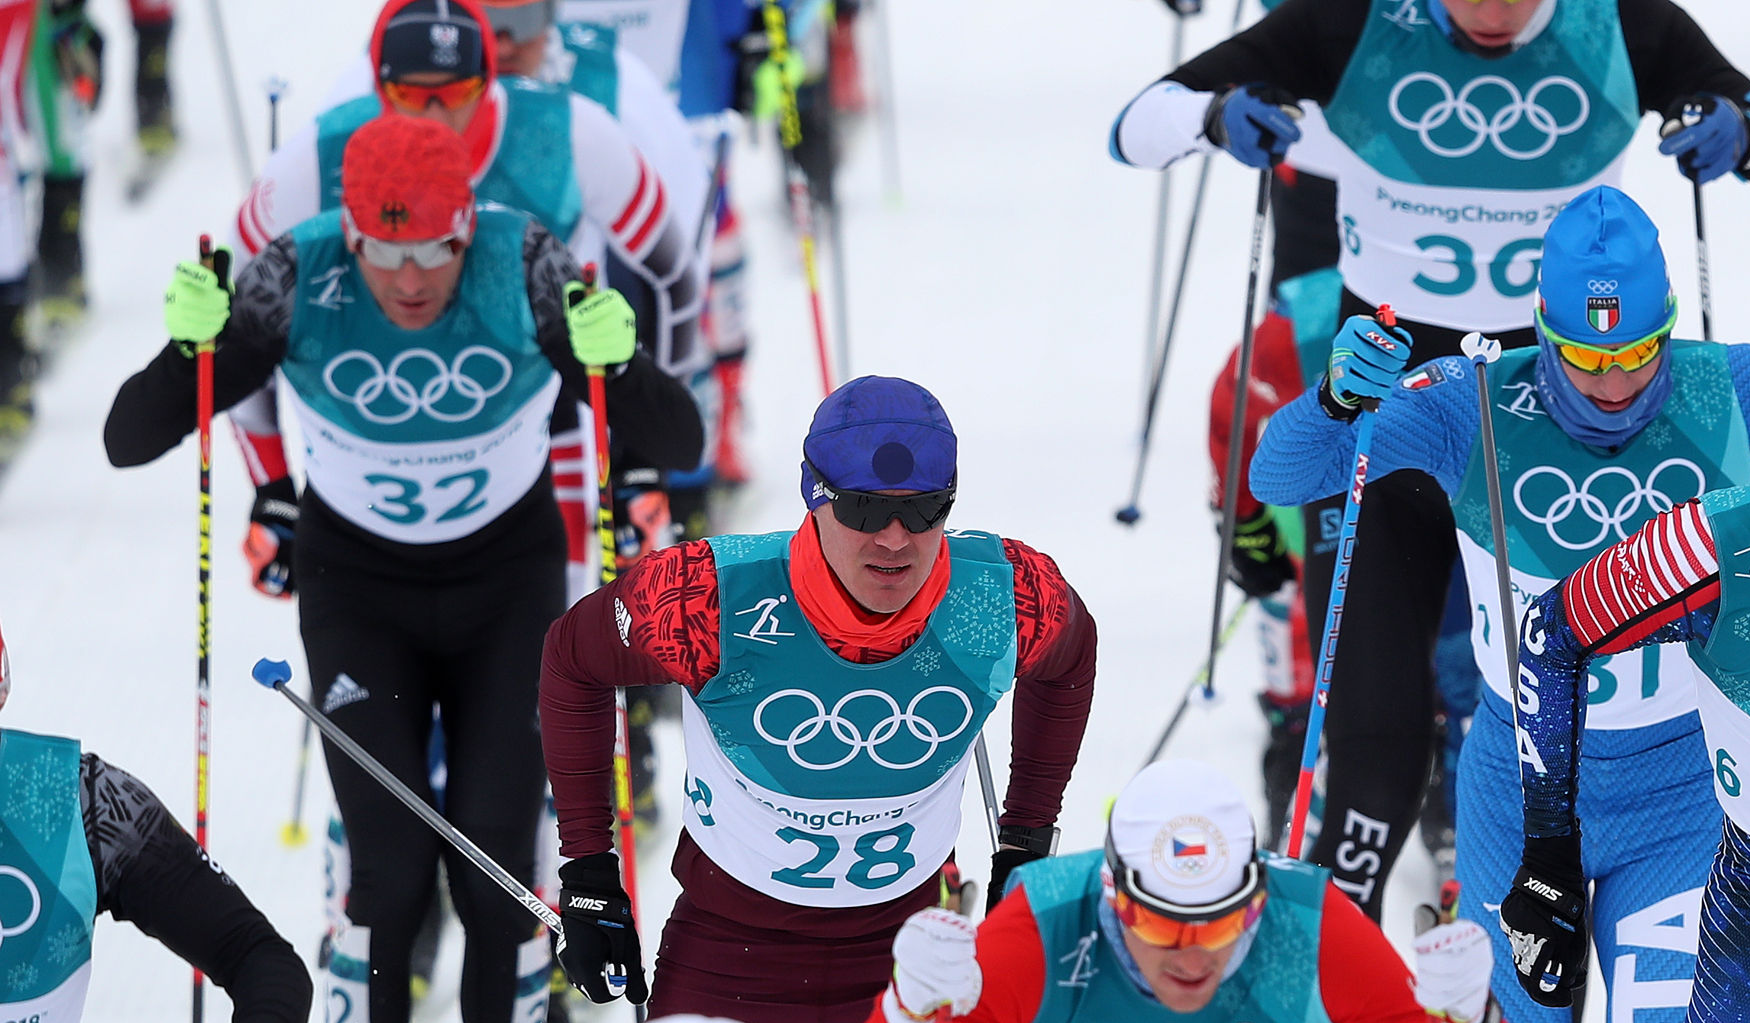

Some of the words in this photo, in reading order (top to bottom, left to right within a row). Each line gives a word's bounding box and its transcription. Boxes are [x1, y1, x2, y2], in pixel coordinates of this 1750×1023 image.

[1377, 187, 1538, 224] PyeongChang
[1413, 234, 1546, 297] 36
[1365, 331, 1397, 350] KV+
[363, 467, 492, 527] 32
[1352, 453, 1370, 505] KV+
[614, 597, 631, 648] adidas
[770, 822, 916, 889] 28
[1334, 808, 1390, 902] EST
